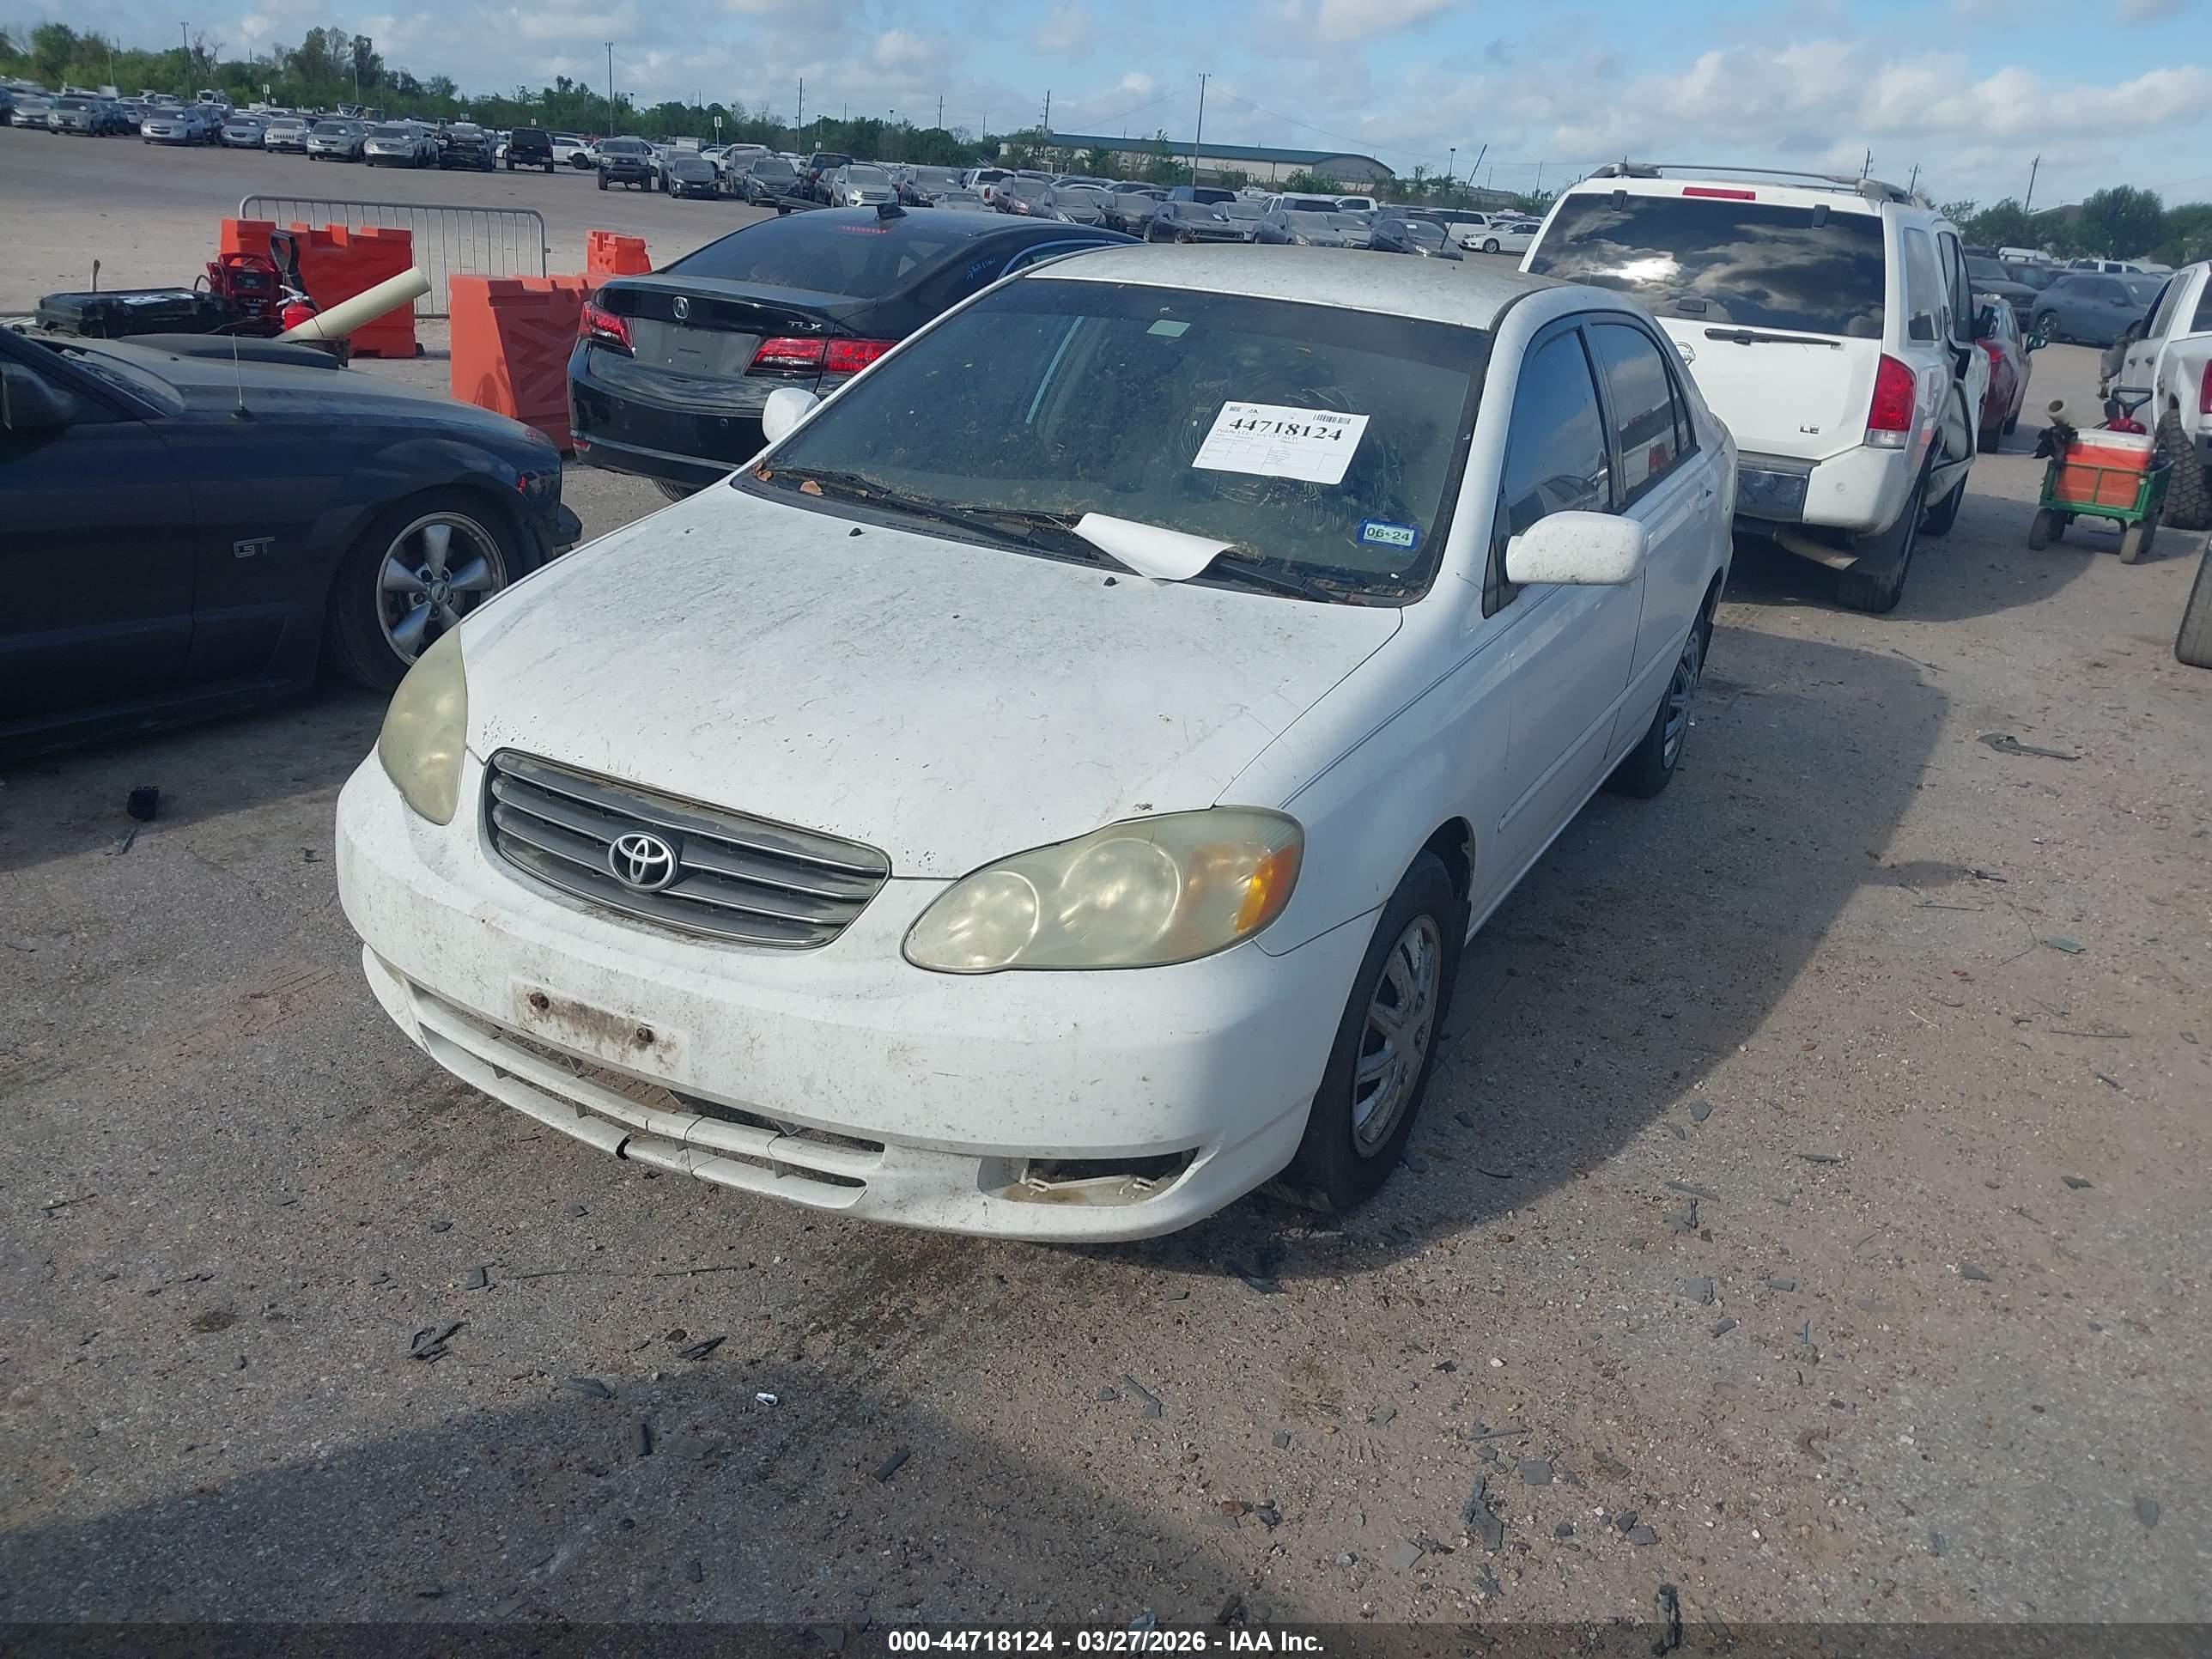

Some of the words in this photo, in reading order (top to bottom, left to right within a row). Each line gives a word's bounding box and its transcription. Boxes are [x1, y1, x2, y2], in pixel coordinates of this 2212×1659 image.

[1229, 418, 1343, 441] 44718124
[1799, 422, 1820, 434] LE
[233, 536, 276, 558] GT
